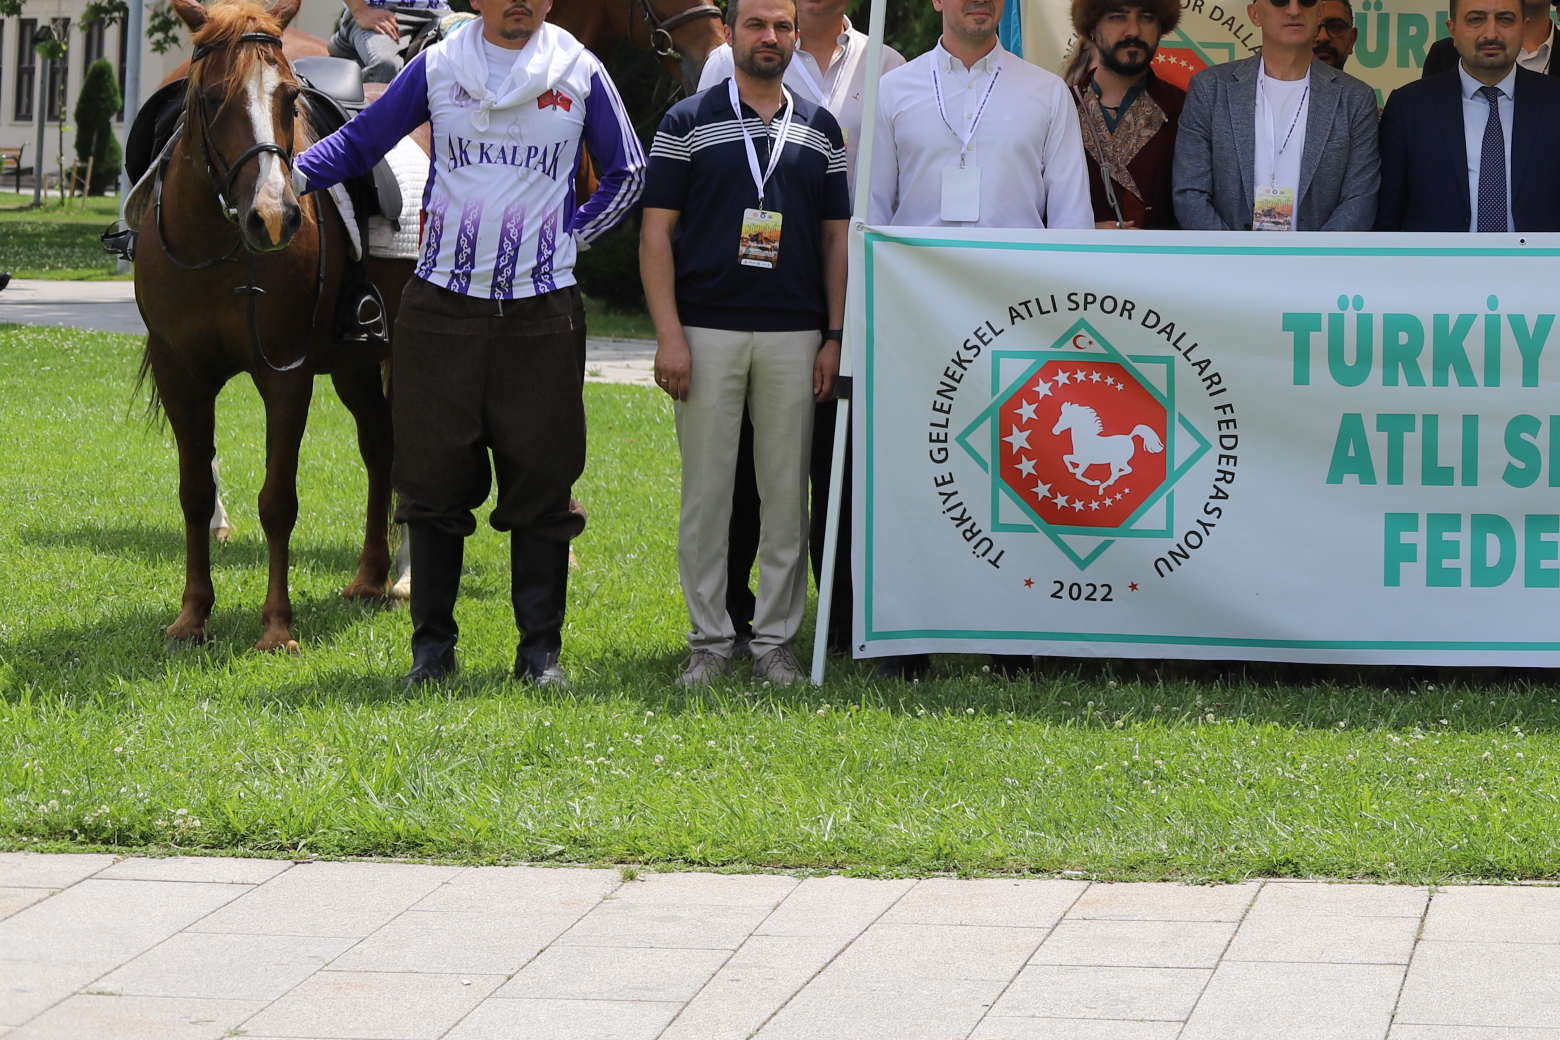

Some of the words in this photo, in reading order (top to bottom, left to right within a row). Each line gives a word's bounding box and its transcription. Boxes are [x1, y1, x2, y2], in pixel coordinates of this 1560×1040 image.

[447, 132, 473, 174] AK
[477, 139, 569, 182] KALPAK
[1008, 294, 1059, 326] ATLI
[1066, 292, 1136, 321] SPOR
[1140, 308, 1227, 398] DALLARI
[928, 320, 1005, 465] GELENEKSEL
[1326, 413, 1479, 487] ATLI
[933, 471, 1005, 569] TÜRKİYE
[1153, 403, 1239, 578] FEDERASYONU
[1050, 580, 1113, 602] 2022
